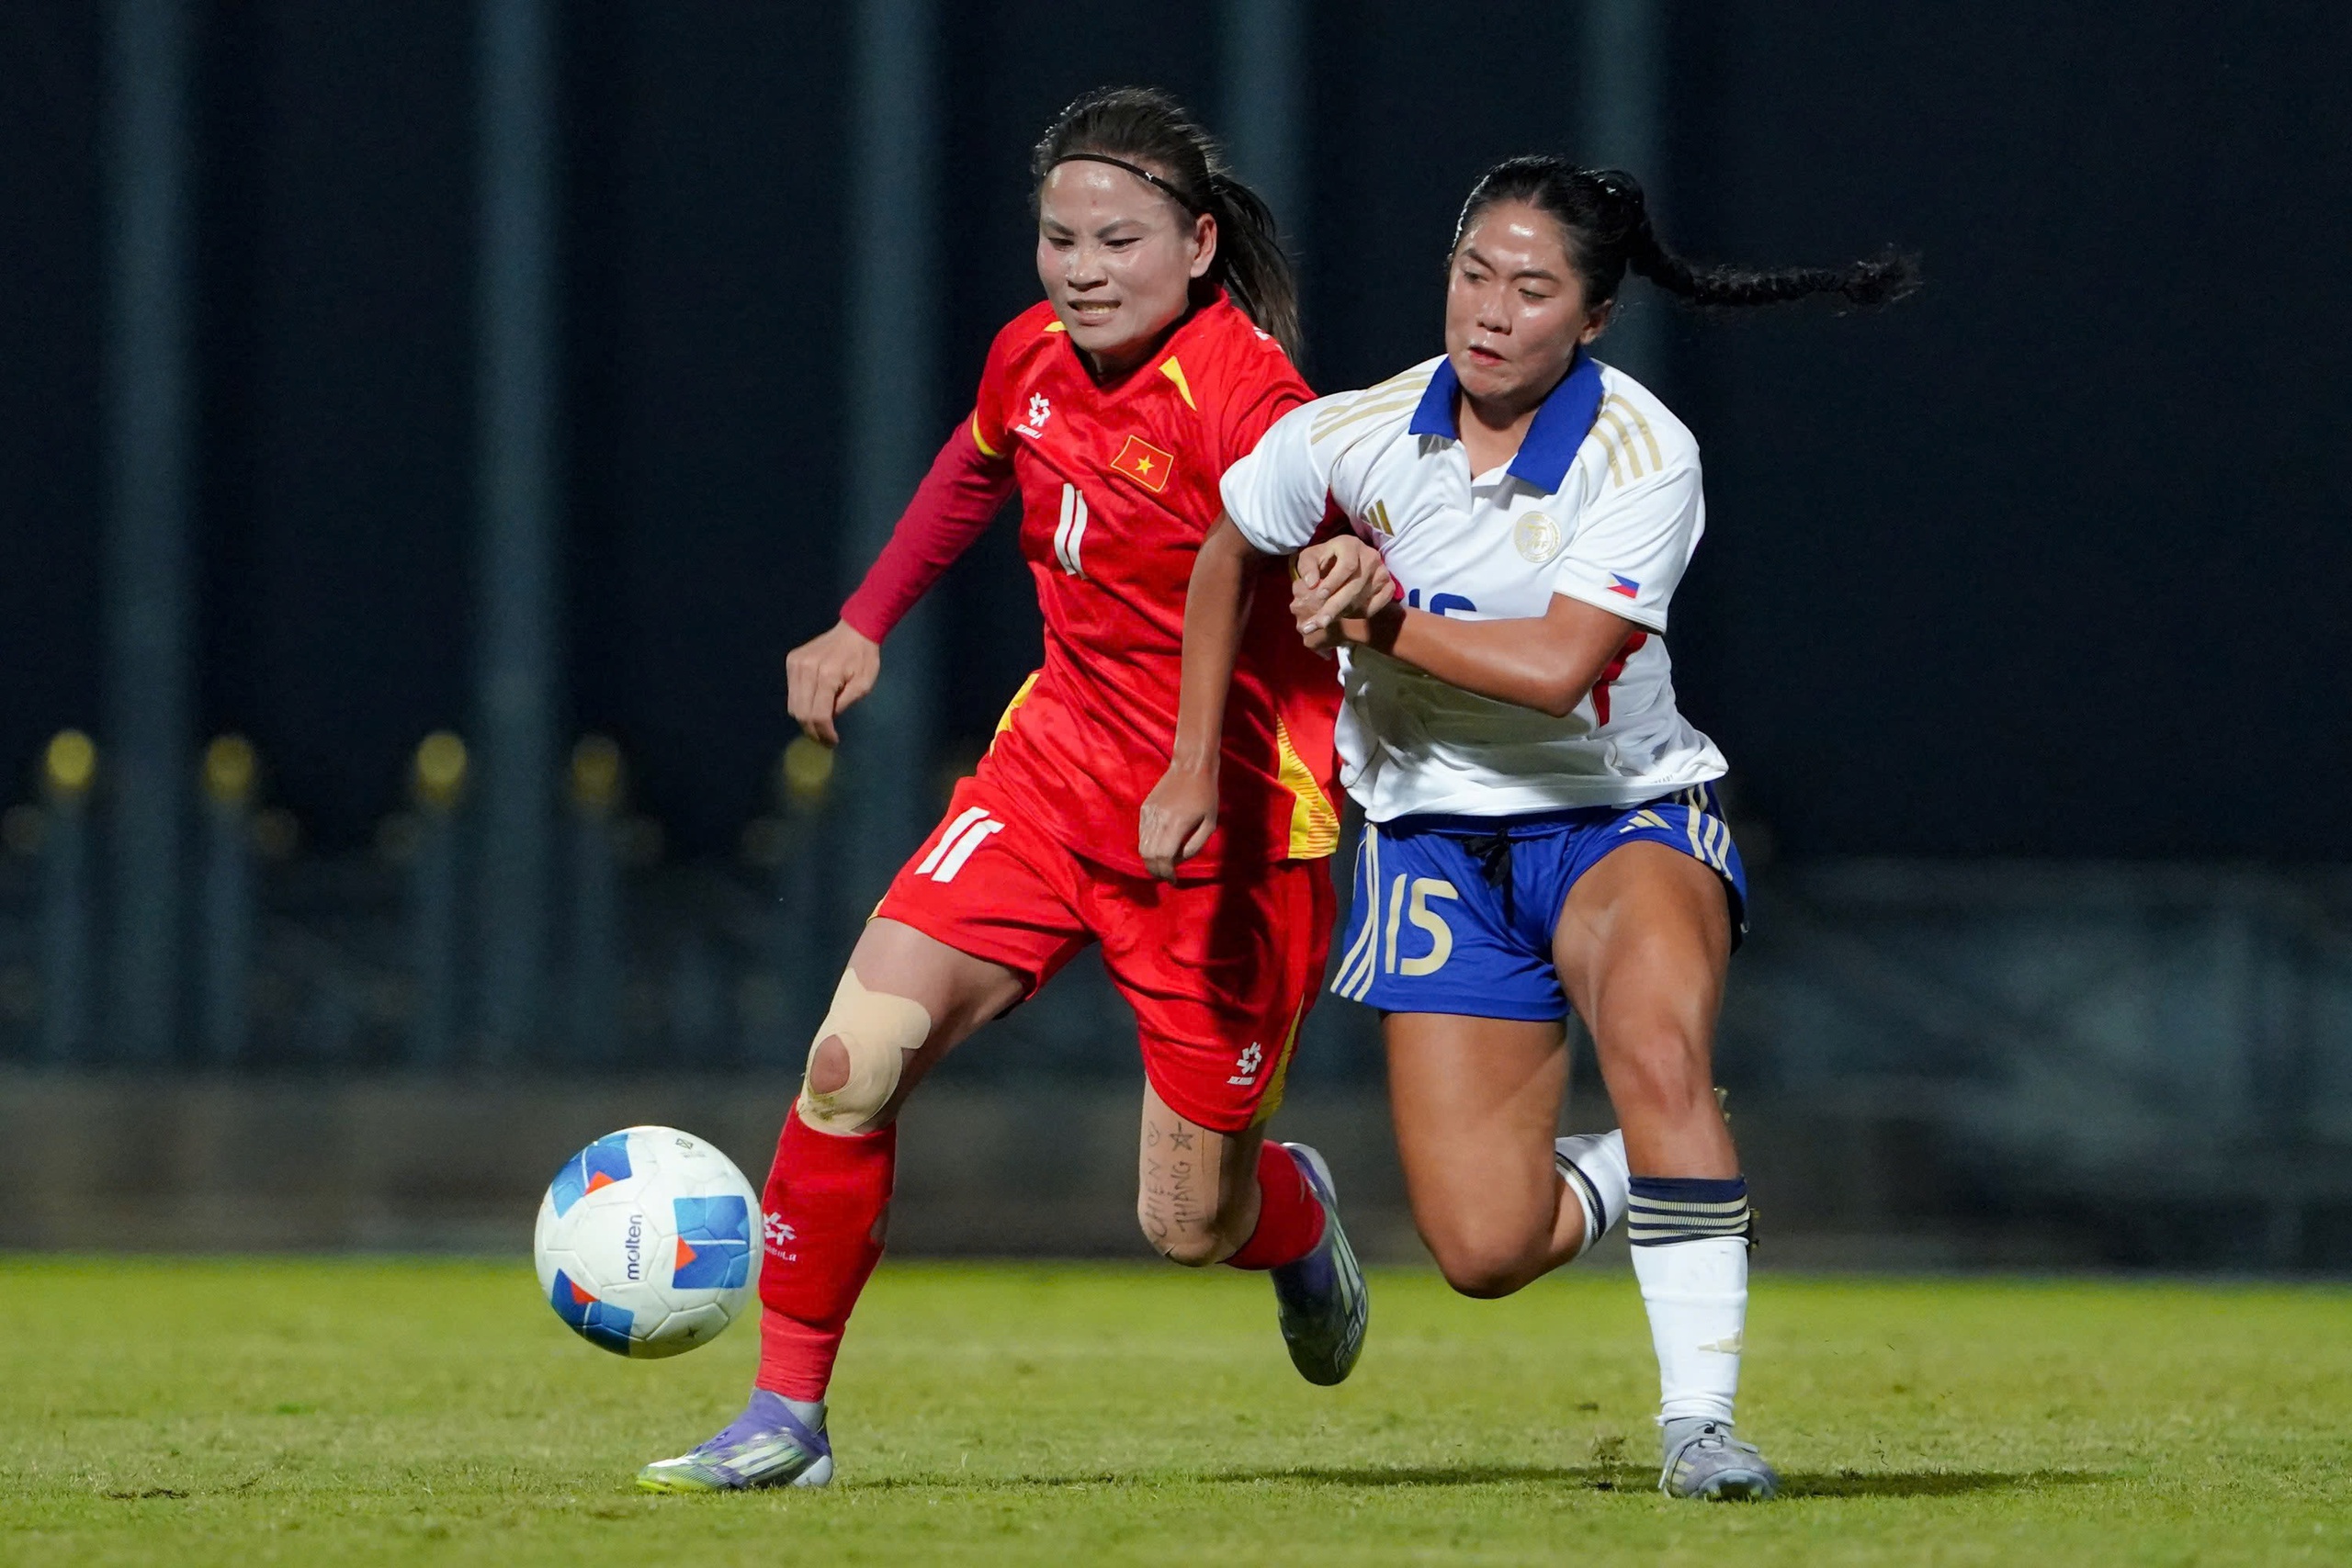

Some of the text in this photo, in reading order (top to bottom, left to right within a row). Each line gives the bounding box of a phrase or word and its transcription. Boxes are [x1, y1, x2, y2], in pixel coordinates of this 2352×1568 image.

[1054, 482, 1089, 580] 11
[913, 806, 1006, 884] 11
[1385, 873, 1459, 976] 15
[627, 1213, 643, 1280] molten
